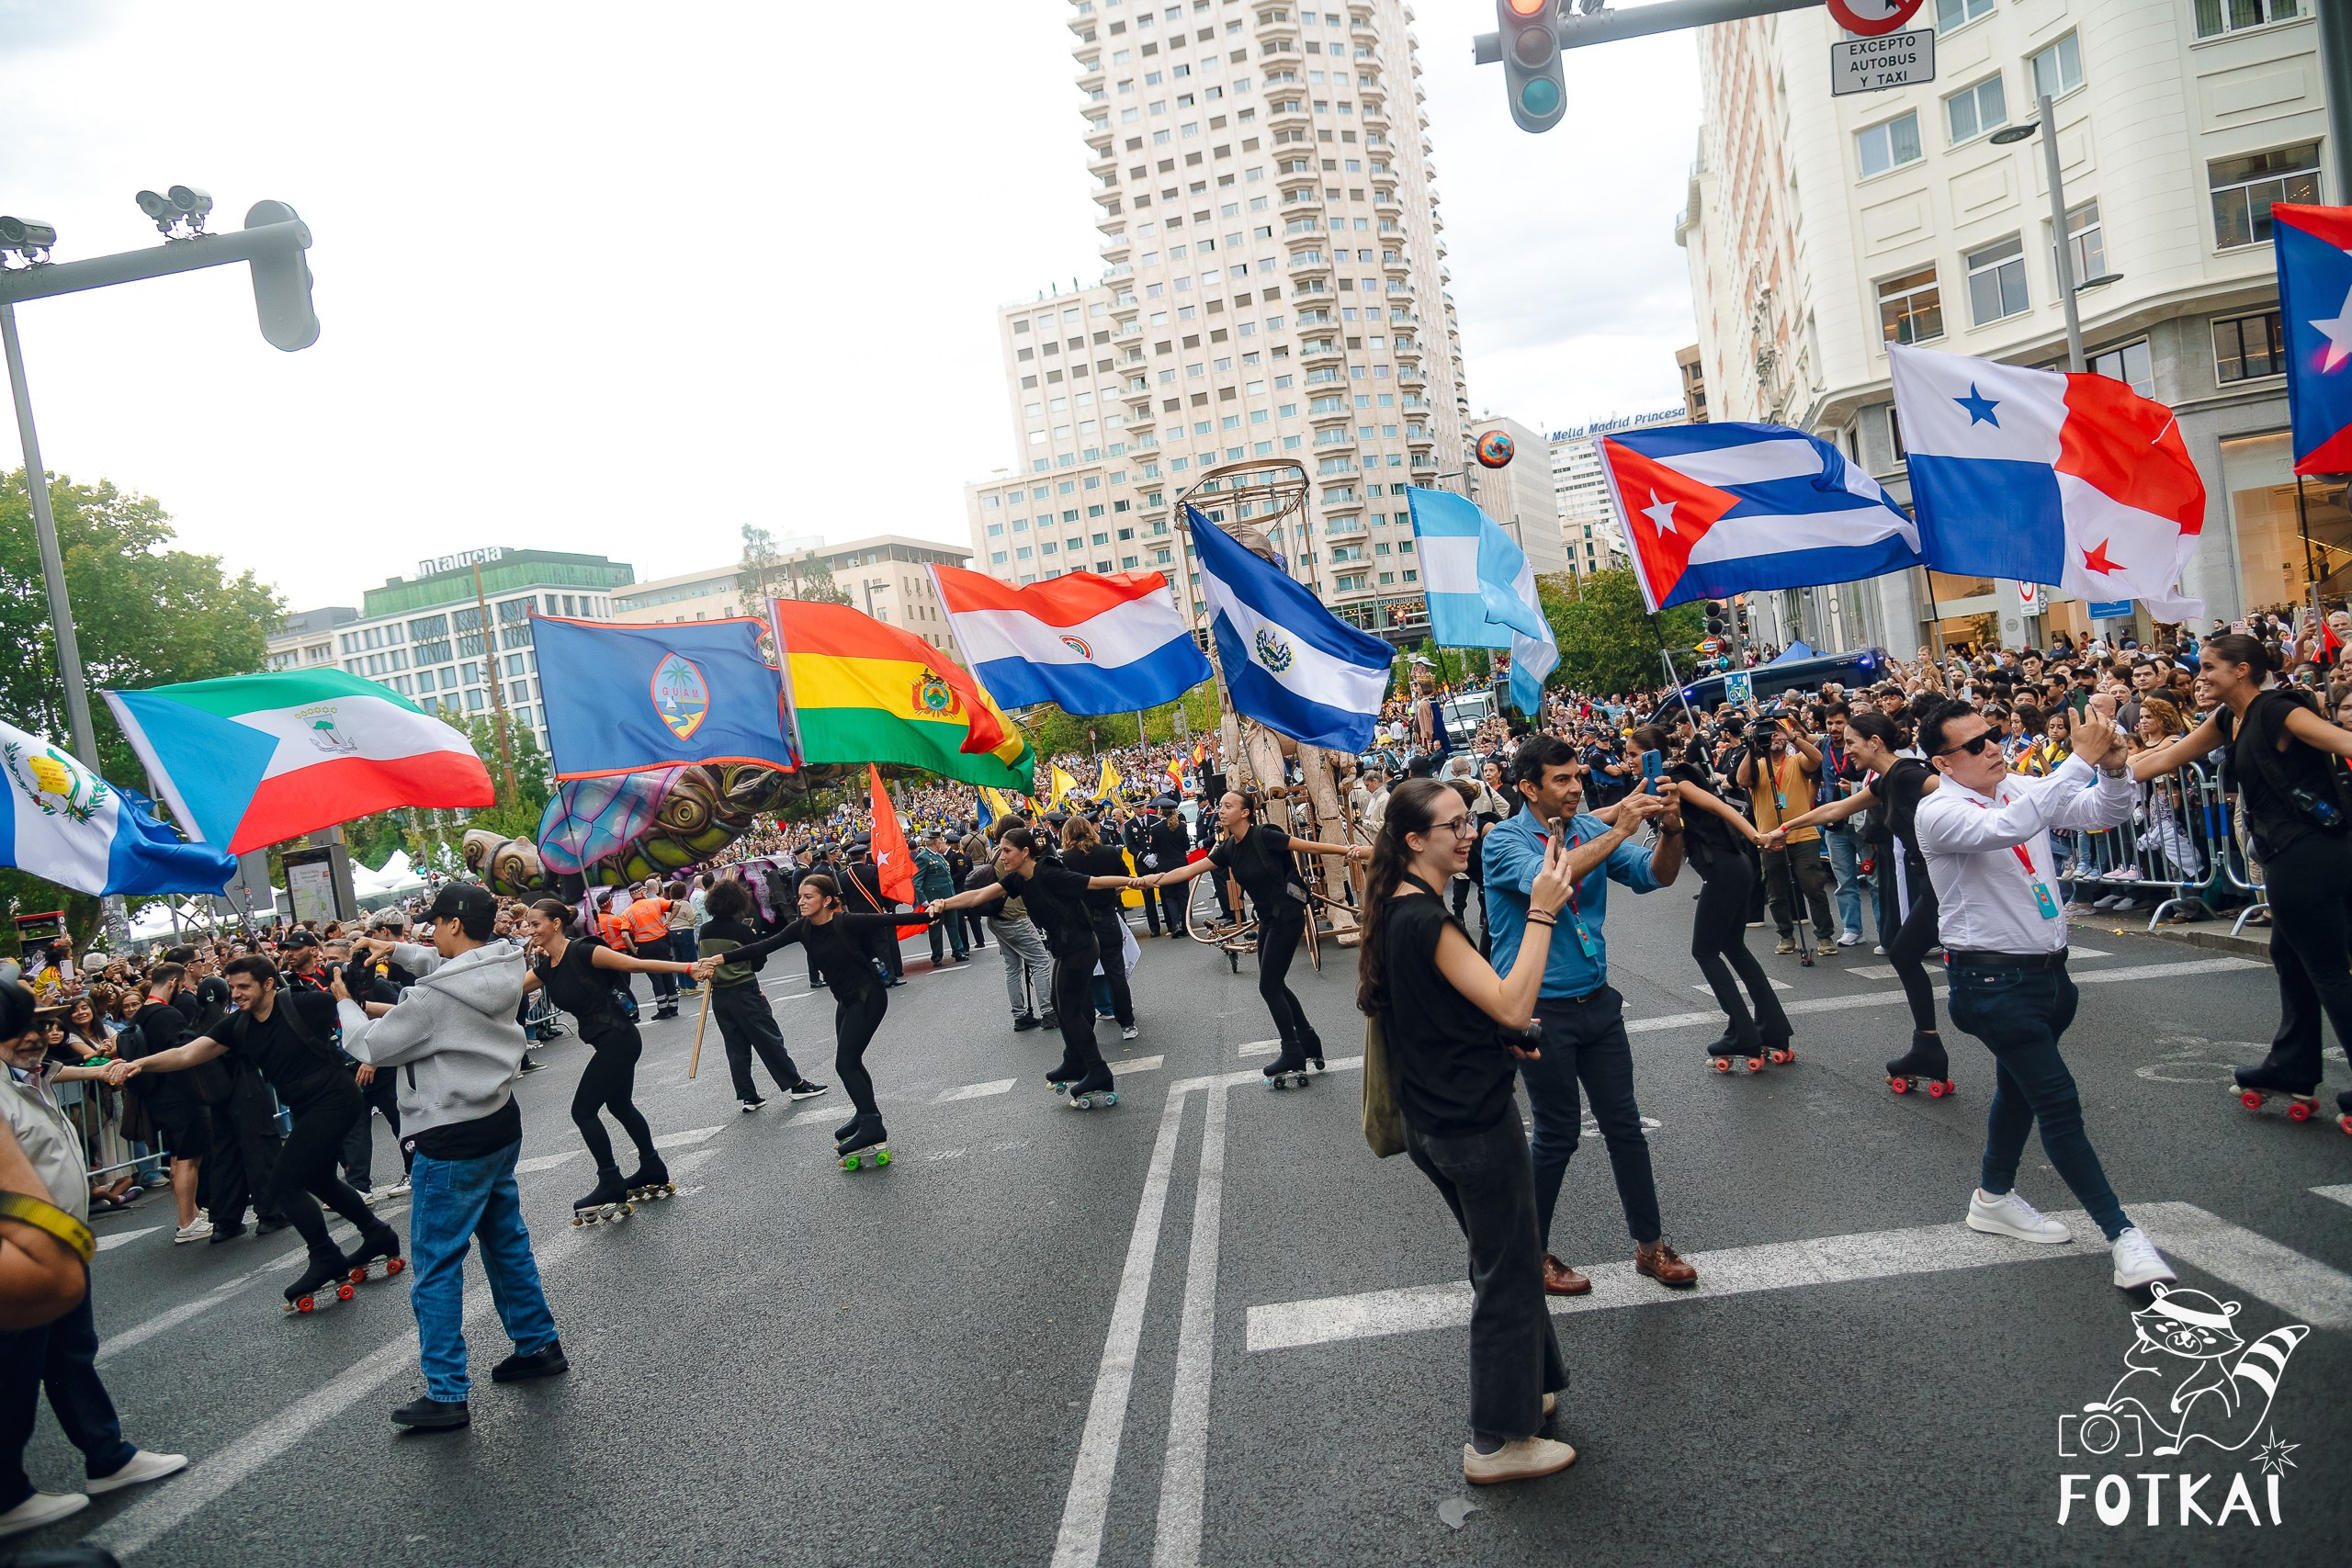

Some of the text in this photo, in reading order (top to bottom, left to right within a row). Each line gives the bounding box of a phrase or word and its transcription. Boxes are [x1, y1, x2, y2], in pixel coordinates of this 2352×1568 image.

[1849, 35, 1916, 55] EXCEPTO
[1849, 52, 1917, 73] AUTOBUS
[1860, 70, 1907, 87] Y TAXI
[1589, 416, 1630, 434] Madrid
[1634, 407, 1686, 425] Princesa
[662, 686, 699, 698] GUAM
